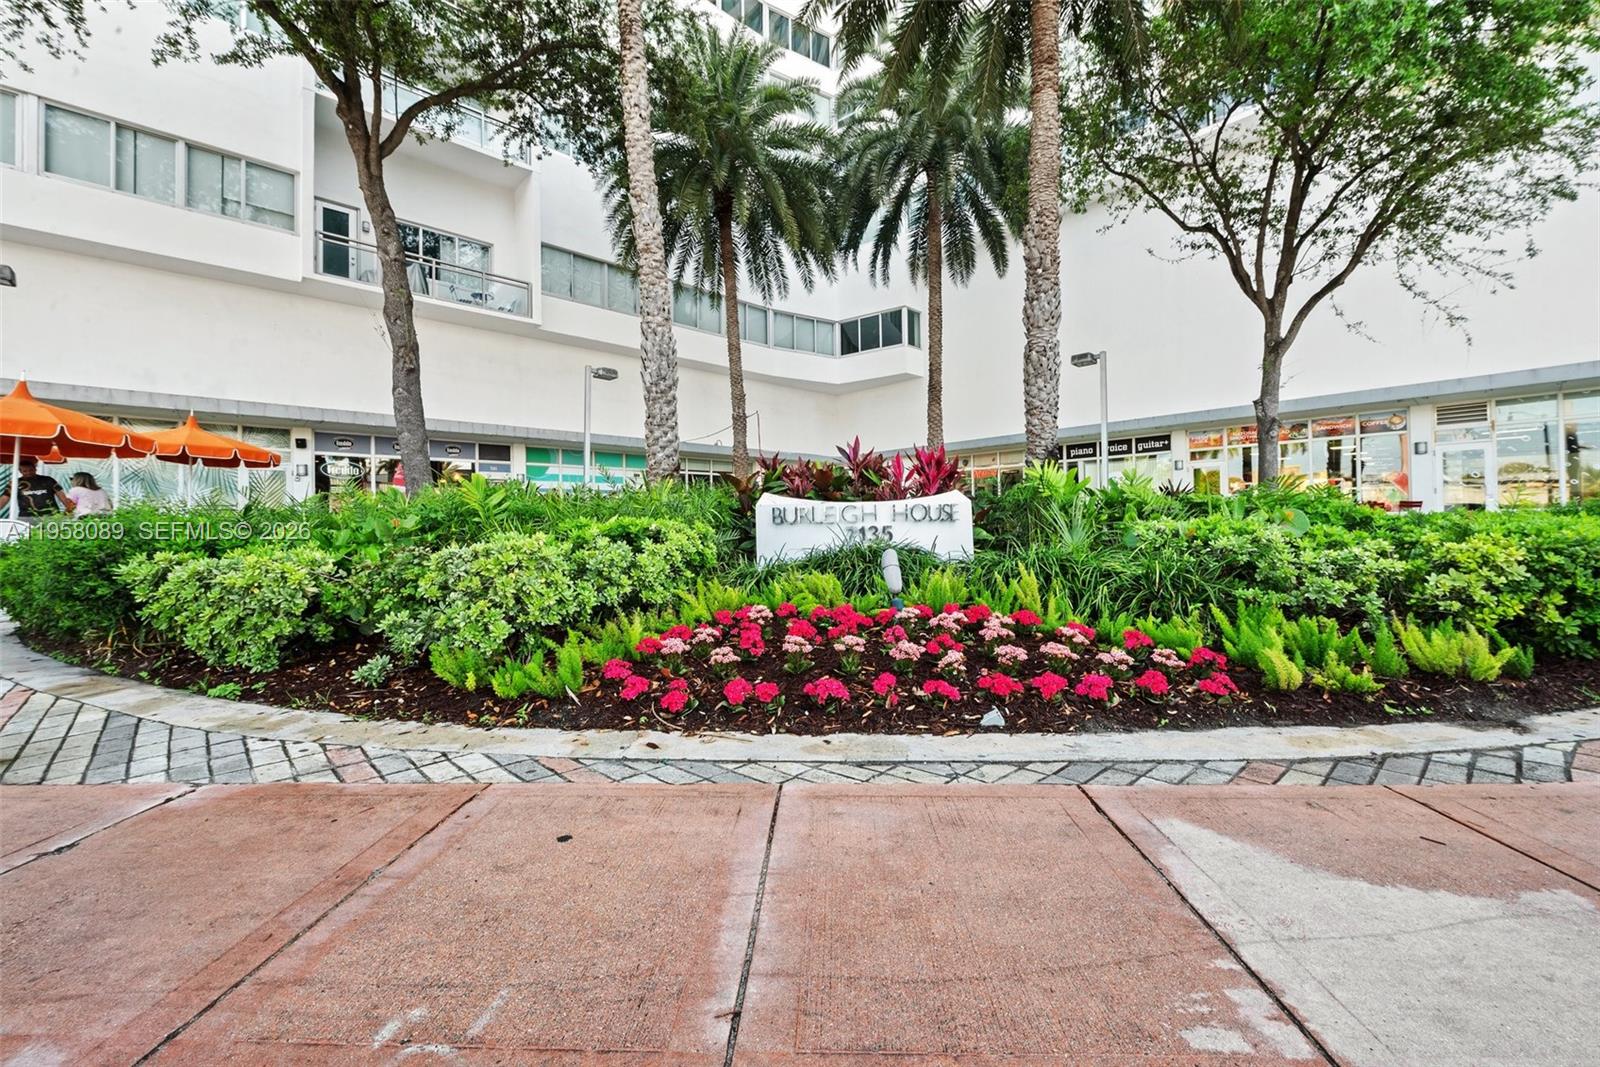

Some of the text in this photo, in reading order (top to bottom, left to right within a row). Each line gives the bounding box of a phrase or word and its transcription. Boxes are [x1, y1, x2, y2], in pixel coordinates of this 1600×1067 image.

[1070, 446, 1094, 457] piano
[771, 503, 960, 526] BURLEIGH HOUSE
